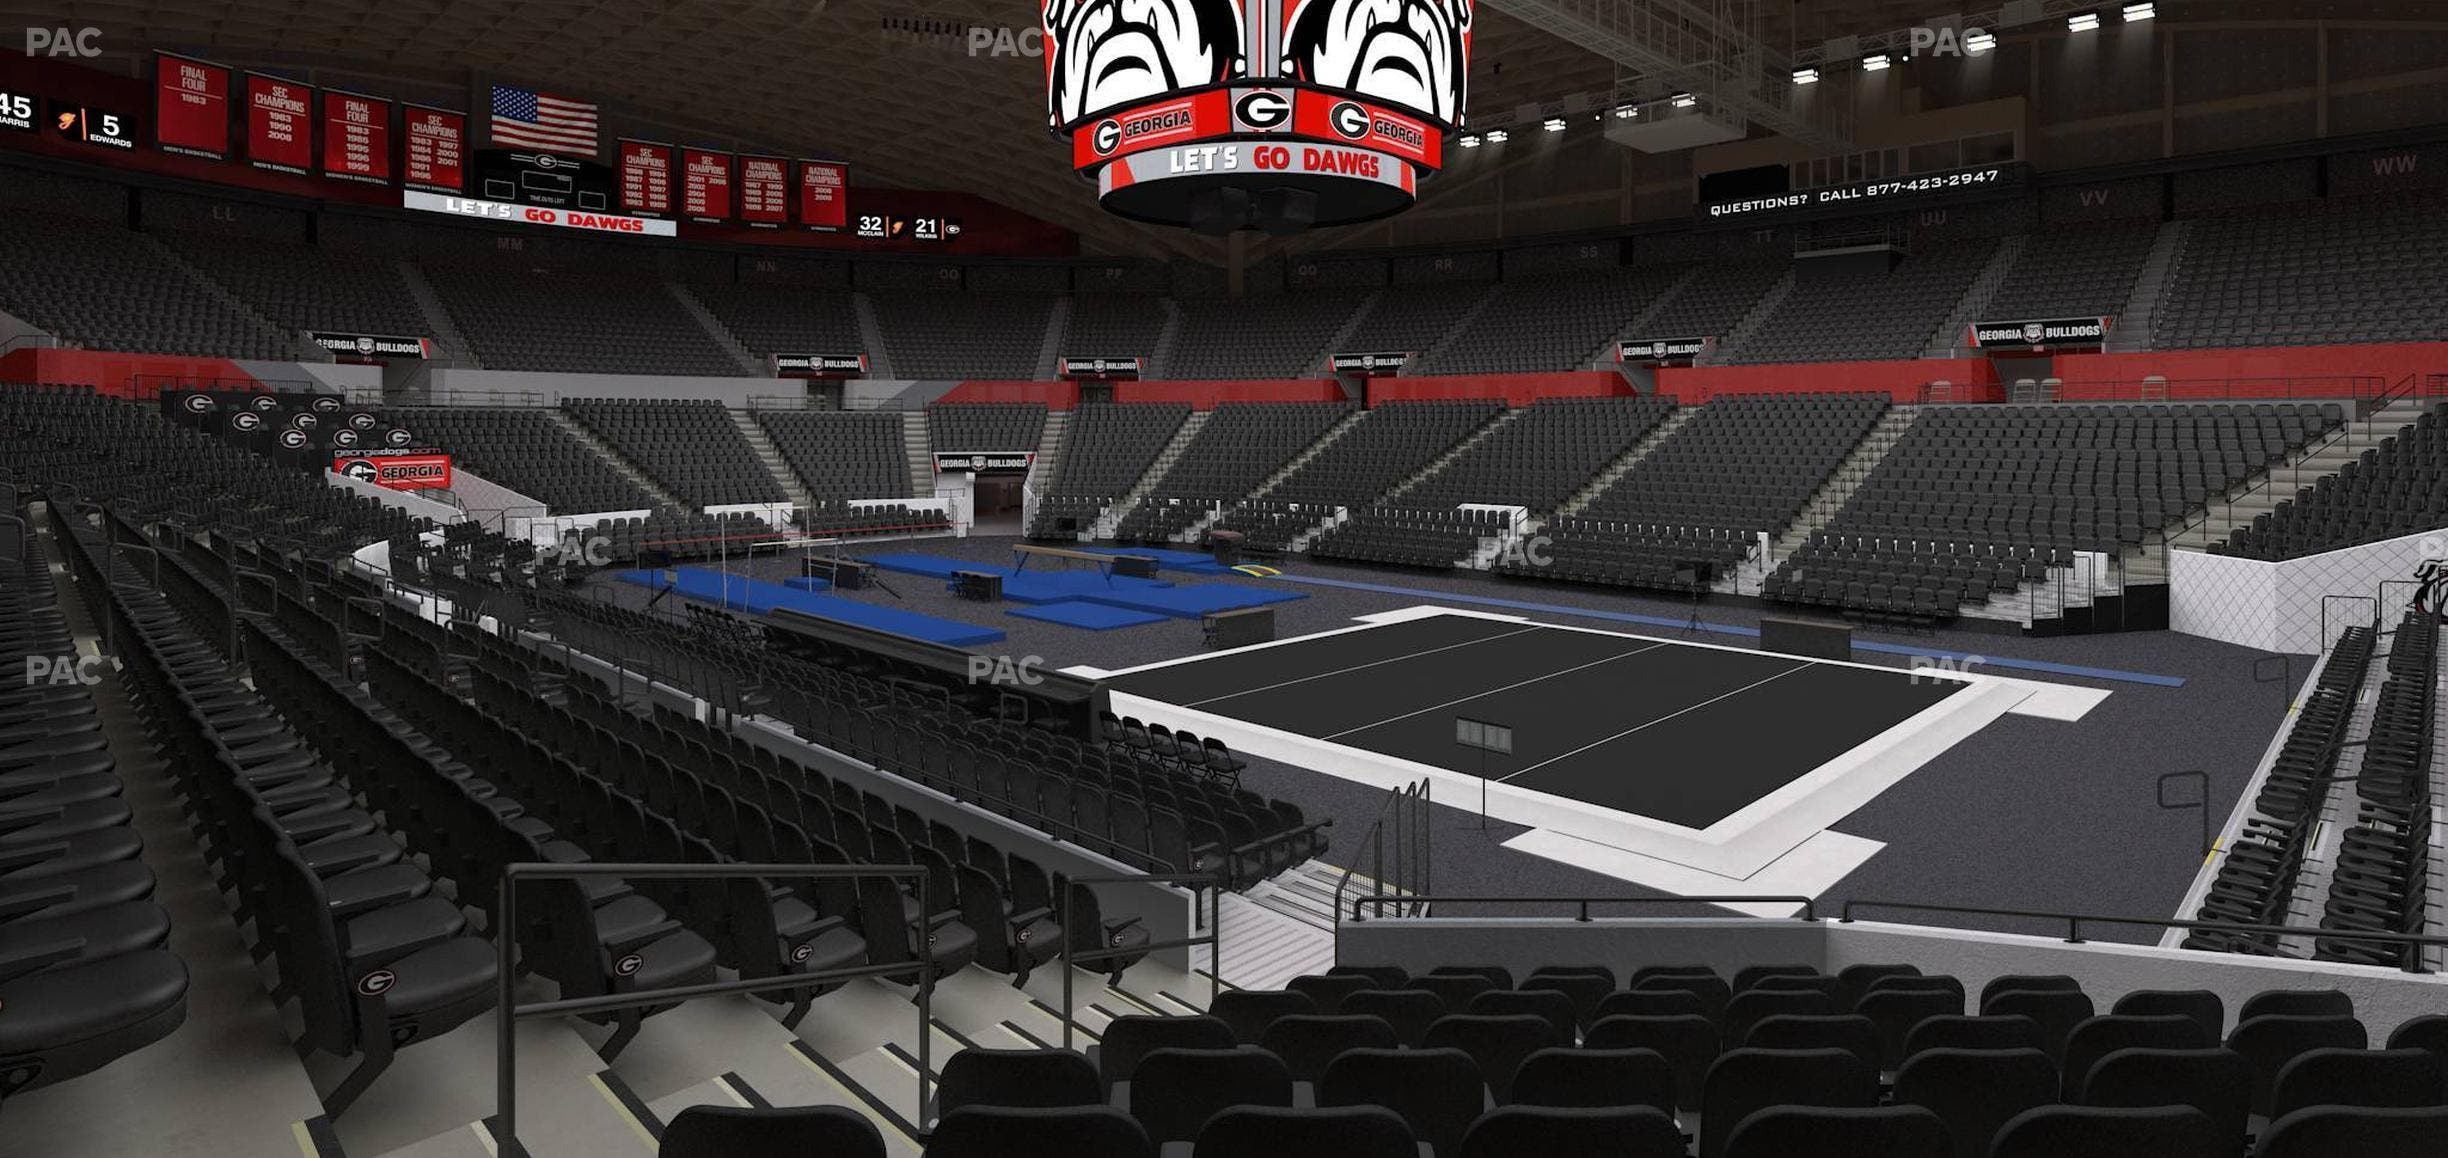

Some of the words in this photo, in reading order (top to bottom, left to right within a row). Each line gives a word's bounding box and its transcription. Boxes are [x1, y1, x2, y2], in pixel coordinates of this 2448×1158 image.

[181, 65, 207, 80] FINAL
[182, 78, 206, 92] FOUR
[272, 86, 288, 98] SEC
[0, 93, 31, 118] 45
[255, 93, 305, 113] CHAMPIONS
[345, 101, 369, 114] FINAL
[270, 112, 292, 122] 1983
[347, 111, 369, 123] FOUR
[428, 115, 442, 126] SEC
[1125, 110, 1191, 138] GEORGIA
[103, 115, 120, 136] 5
[412, 122, 457, 139] CHAMPIONS
[90, 133, 132, 147] EDWARDS
[1374, 120, 1423, 147] GEORGIA
[626, 155, 666, 168] CHAMPIONS
[748, 161, 779, 172] NATIONAL
[1170, 146, 1238, 174] LET'S
[1254, 146, 1290, 170] GO
[1304, 148, 1379, 178] DAWGS
[2372, 154, 2417, 175] WW
[688, 163, 725, 175] CHAMPIONS
[746, 169, 782, 181] CHAMPIONS
[1710, 194, 1808, 217] QUESTIONS?
[1820, 190, 1861, 202] CALL
[1867, 170, 1998, 196] 877-423-2947
[2079, 189, 2108, 207] VV
[212, 207, 235, 221] LL
[446, 198, 511, 218] LET'S
[525, 208, 556, 223] GO
[567, 213, 644, 231] DAWGS
[860, 216, 882, 231] 32
[915, 219, 935, 233] 21
[1980, 329, 2022, 341] GEORGIA
[2046, 325, 2100, 338] BULLDOGS
[376, 342, 420, 353] BULLDOGS
[1623, 346, 1652, 356] GEORGIA
[779, 359, 809, 367] GEORGIA
[824, 360, 859, 368] BULLDOGS
[1068, 362, 1093, 370] GEORGIA
[1106, 362, 1137, 370] BULLDOGS
[1335, 359, 1362, 367] GEORGIA
[334, 448, 442, 457] georgiadogs.com
[940, 459, 970, 468] GEORGIA
[987, 459, 1027, 468] BULLDOGS
[381, 466, 443, 478] GEORGIA
